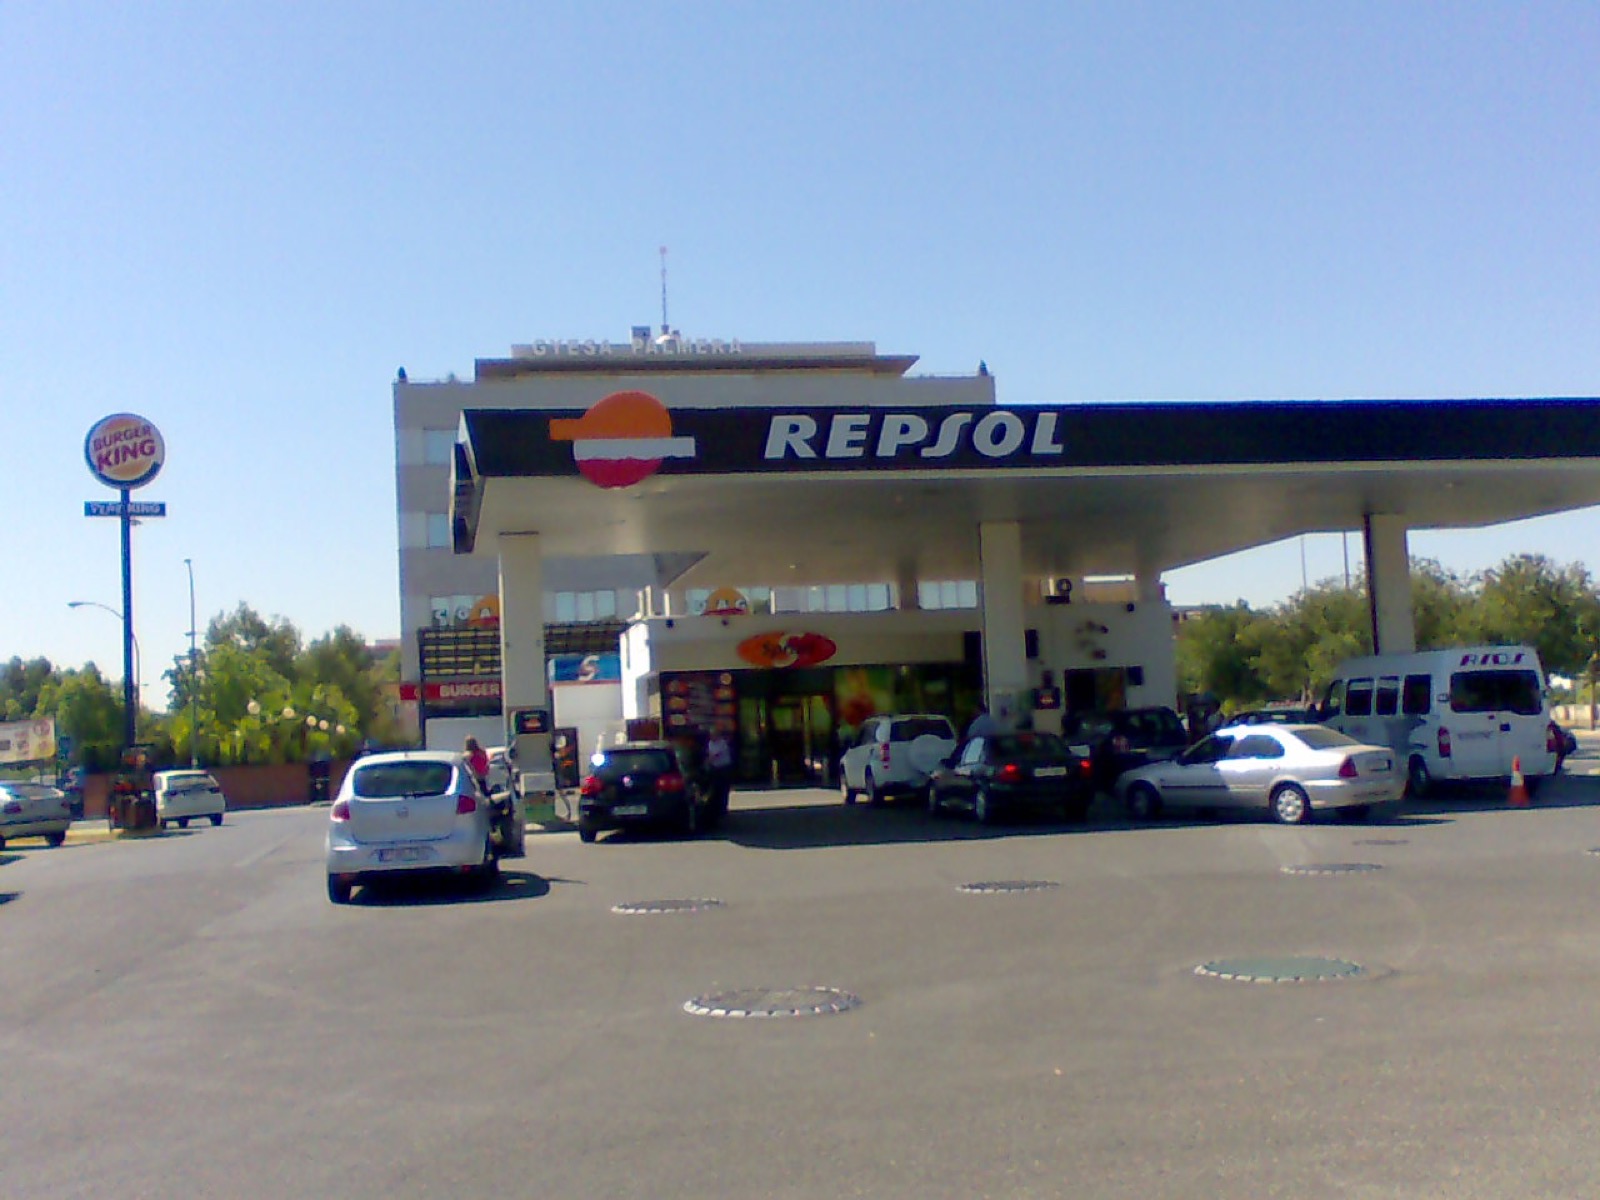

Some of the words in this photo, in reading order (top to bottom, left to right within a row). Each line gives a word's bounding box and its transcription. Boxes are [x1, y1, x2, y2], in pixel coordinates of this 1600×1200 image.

[631, 337, 742, 355] PALMERA
[92, 425, 152, 452] BURGER
[764, 410, 1065, 459] REPSOL
[96, 439, 156, 472] KING
[439, 683, 500, 698] BURGER
